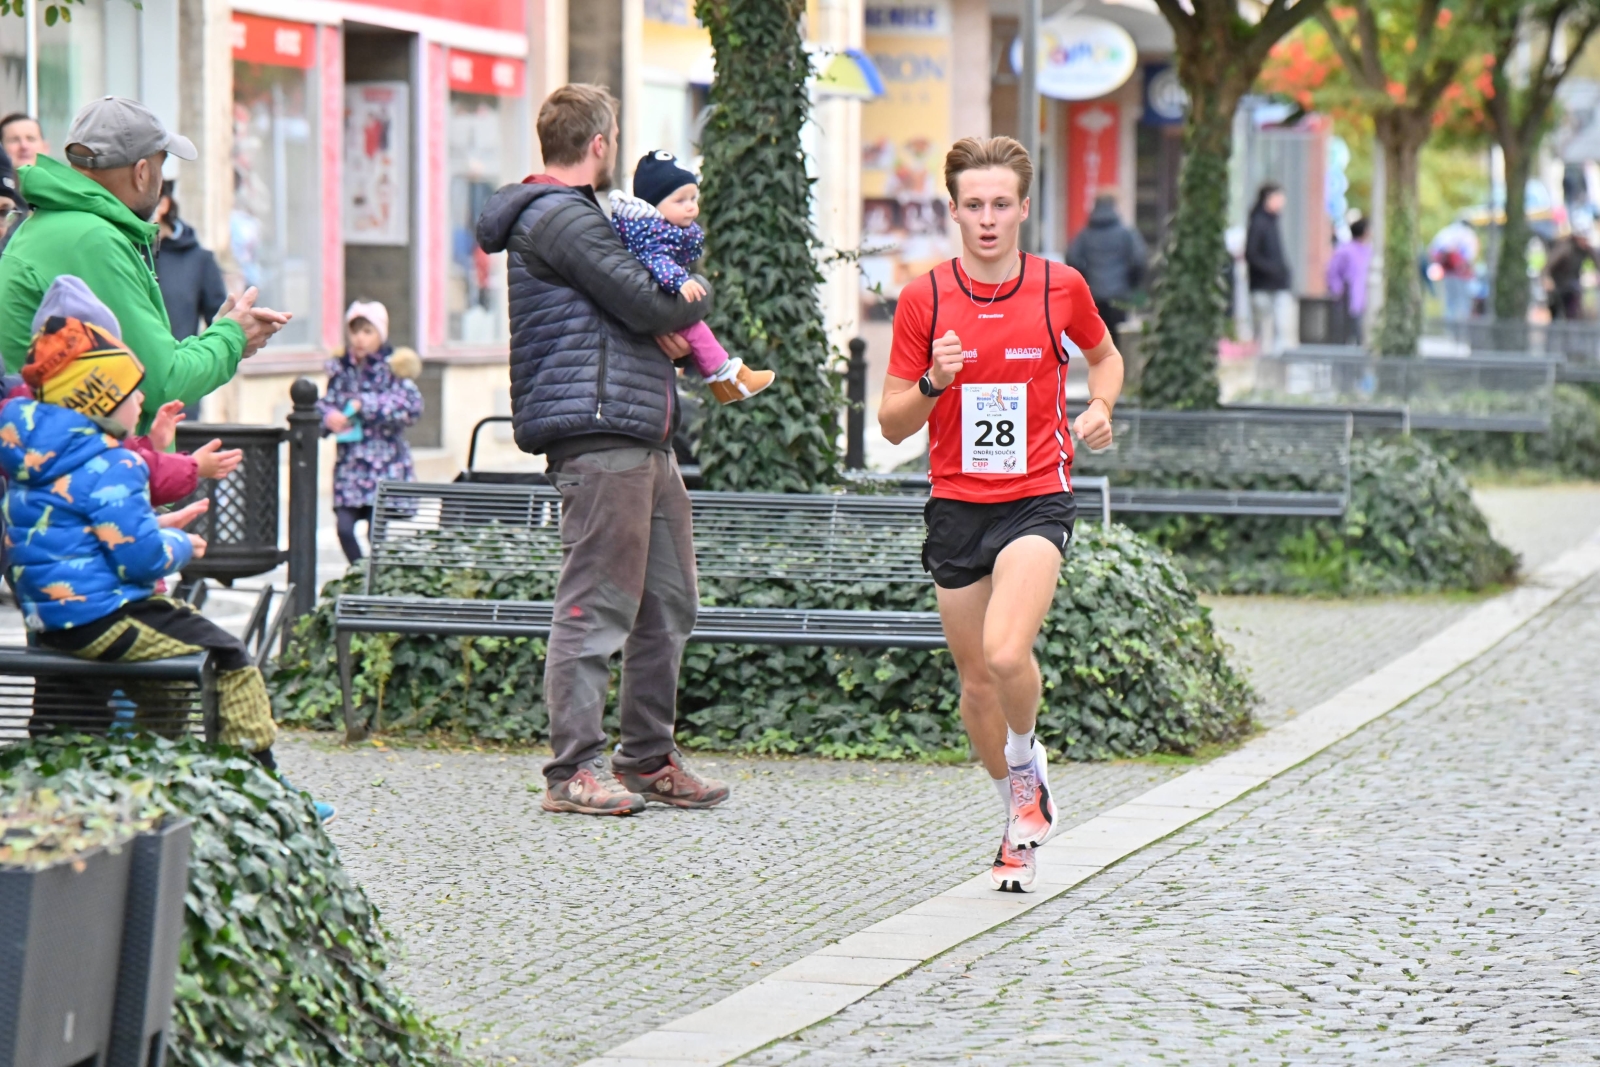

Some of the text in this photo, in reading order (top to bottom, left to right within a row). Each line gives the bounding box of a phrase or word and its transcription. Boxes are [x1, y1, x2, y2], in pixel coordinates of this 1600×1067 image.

[1004, 347, 1042, 355] MARATON
[62, 366, 113, 410] AME
[974, 420, 1015, 447] 28
